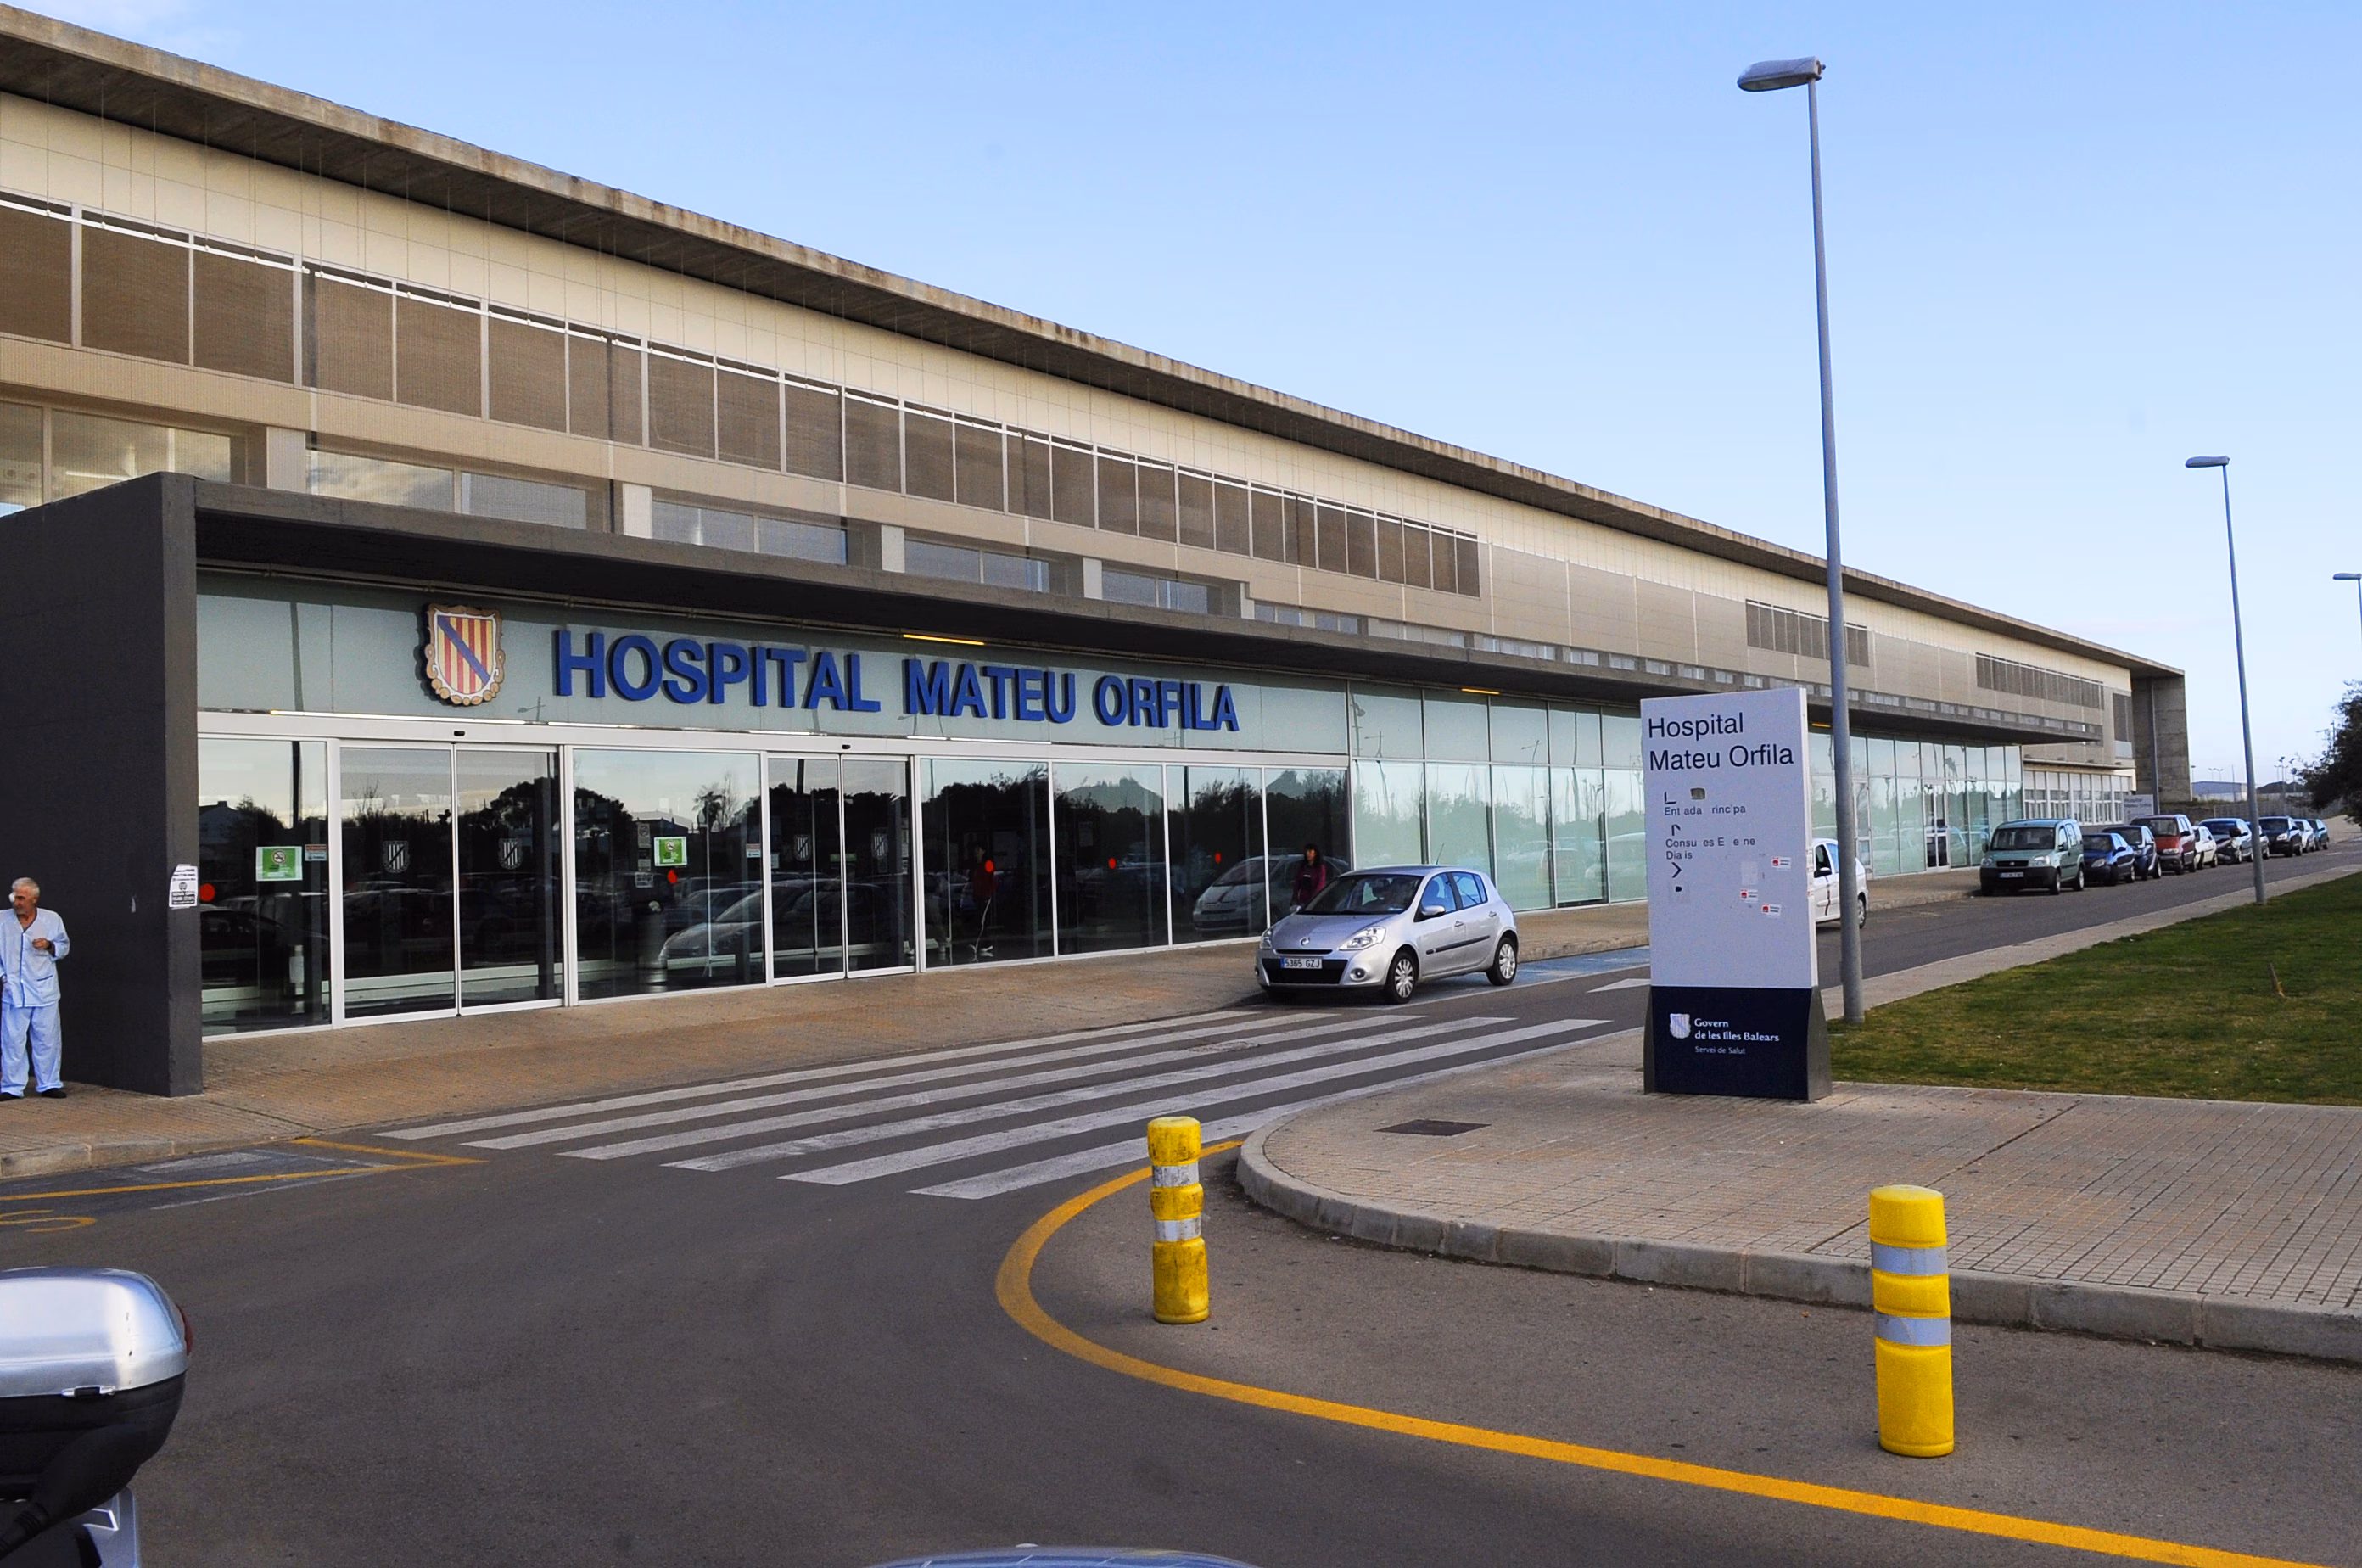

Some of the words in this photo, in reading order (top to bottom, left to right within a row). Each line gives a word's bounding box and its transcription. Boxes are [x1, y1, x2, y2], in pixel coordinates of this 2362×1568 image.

[552, 630, 881, 713] HOSPITAL
[902, 658, 1076, 724] MATEU
[1092, 675, 1240, 731] ORFILA
[1648, 712, 1744, 741] Hospital
[1649, 749, 1721, 771] Mateu
[1729, 743, 1794, 767] Orfila
[1664, 806, 1703, 816] Entada
[1711, 804, 1746, 815] rincpa
[1665, 838, 1715, 848] Consues
[1717, 837, 1756, 847] Eene
[1665, 850, 1693, 860] Diais
[1305, 959, 1320, 968] GZJ
[1693, 1018, 1729, 1028] Govern
[1694, 1030, 1706, 1039] de
[1708, 1030, 1721, 1040] les
[1722, 1030, 1742, 1041] Illes
[1744, 1032, 1780, 1042] Balears
[1694, 1045, 1716, 1054] Servei
[1728, 1046, 1746, 1055] Salut
